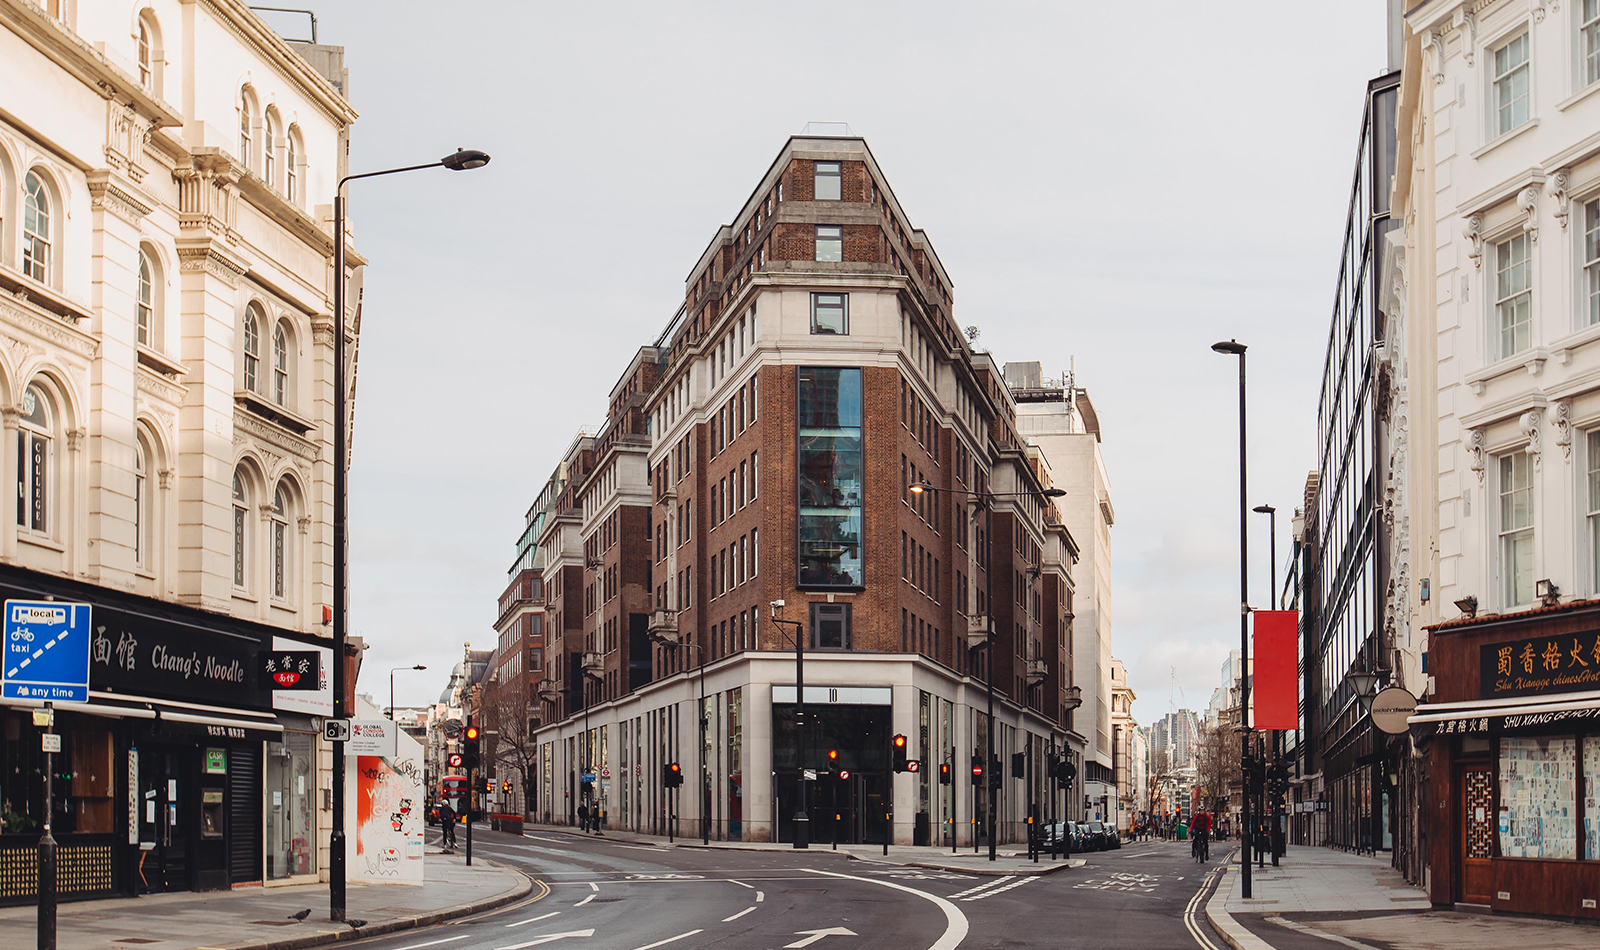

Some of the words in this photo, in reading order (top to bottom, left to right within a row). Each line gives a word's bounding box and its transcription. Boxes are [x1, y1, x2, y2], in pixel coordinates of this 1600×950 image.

[30, 608, 55, 618] local
[11, 643, 30, 653] taxi
[151, 644, 201, 679] Chang's
[203, 655, 244, 683] Noodle
[1494, 678, 1513, 692] Shu
[31, 688, 49, 698] any
[52, 687, 74, 698] time
[829, 688, 838, 703] 10
[1503, 715, 1521, 729] SHU
[1521, 712, 1555, 727] XIANG
[209, 751, 224, 760] CASH
